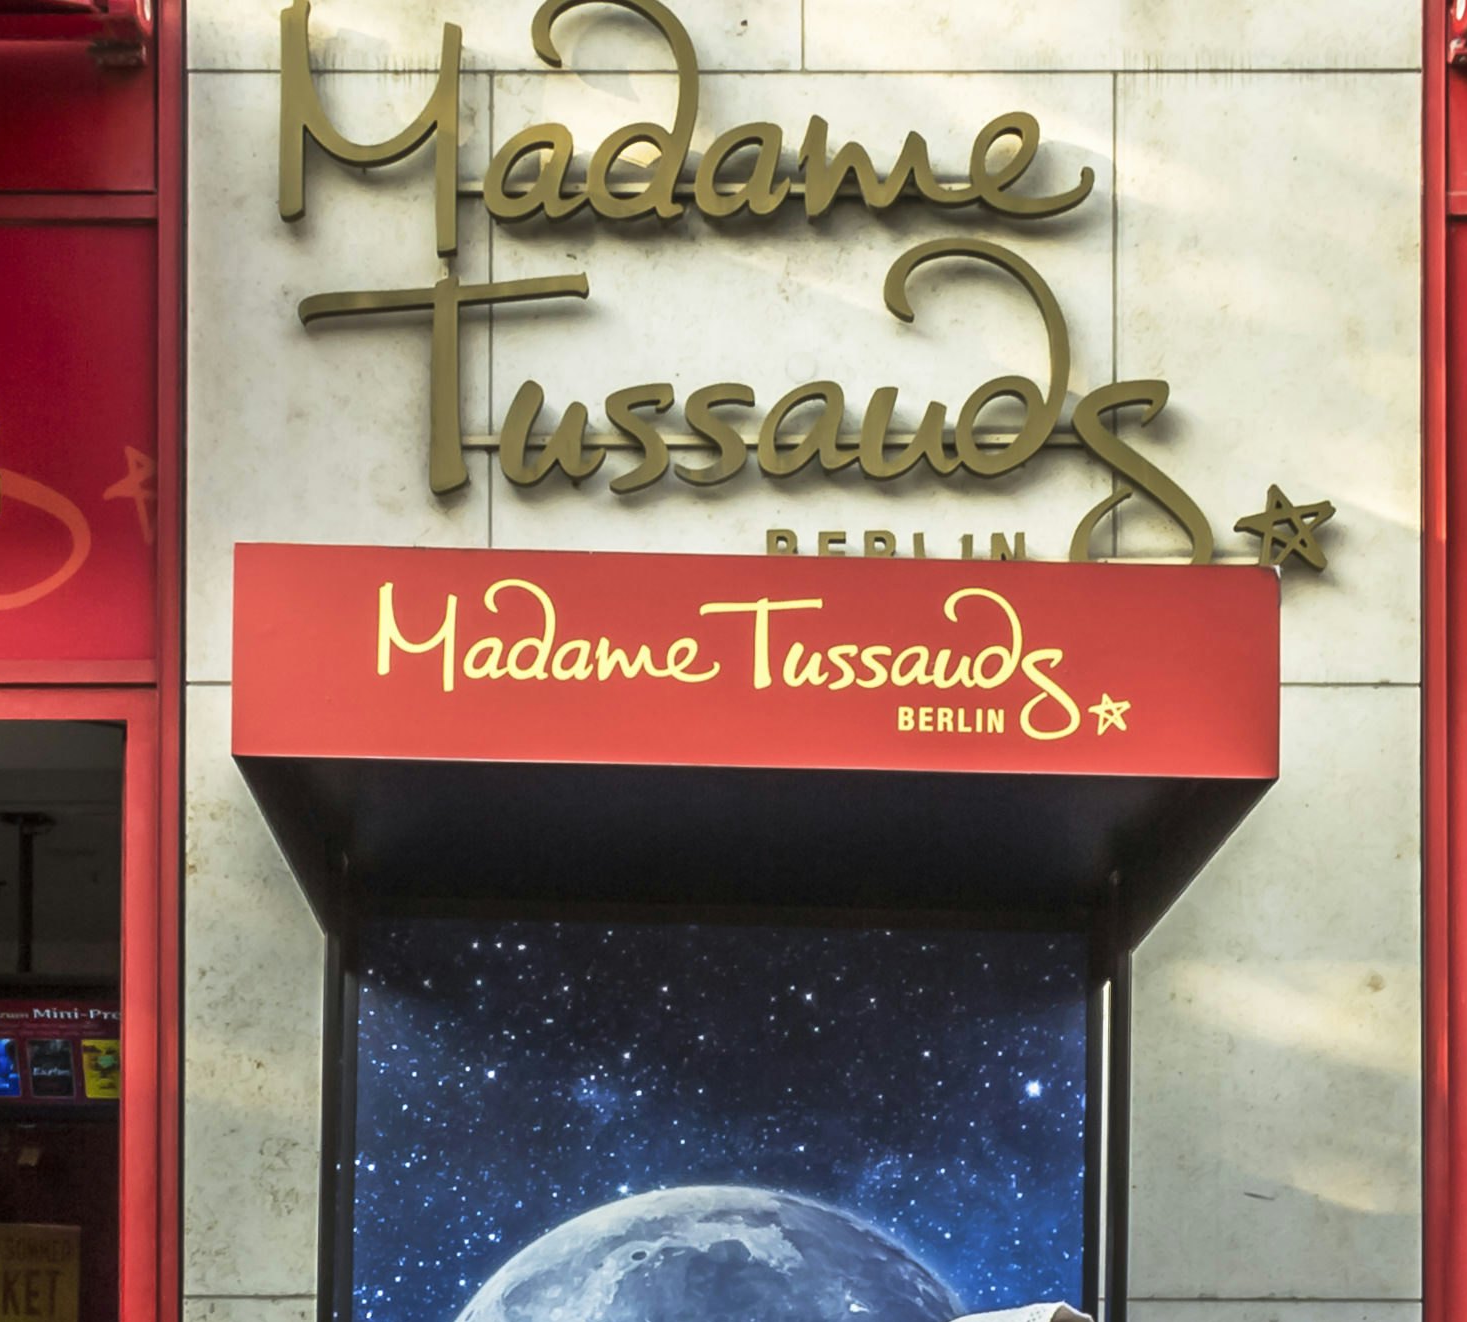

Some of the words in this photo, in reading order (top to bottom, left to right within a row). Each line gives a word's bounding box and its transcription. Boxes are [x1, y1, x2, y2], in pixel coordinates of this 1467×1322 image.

[279, 0, 1095, 257] Madame
[298, 238, 1212, 563] Tussauds
[377, 578, 720, 692] Madame
[699, 587, 1081, 740] Tussauds
[897, 706, 1005, 733] BERLIN
